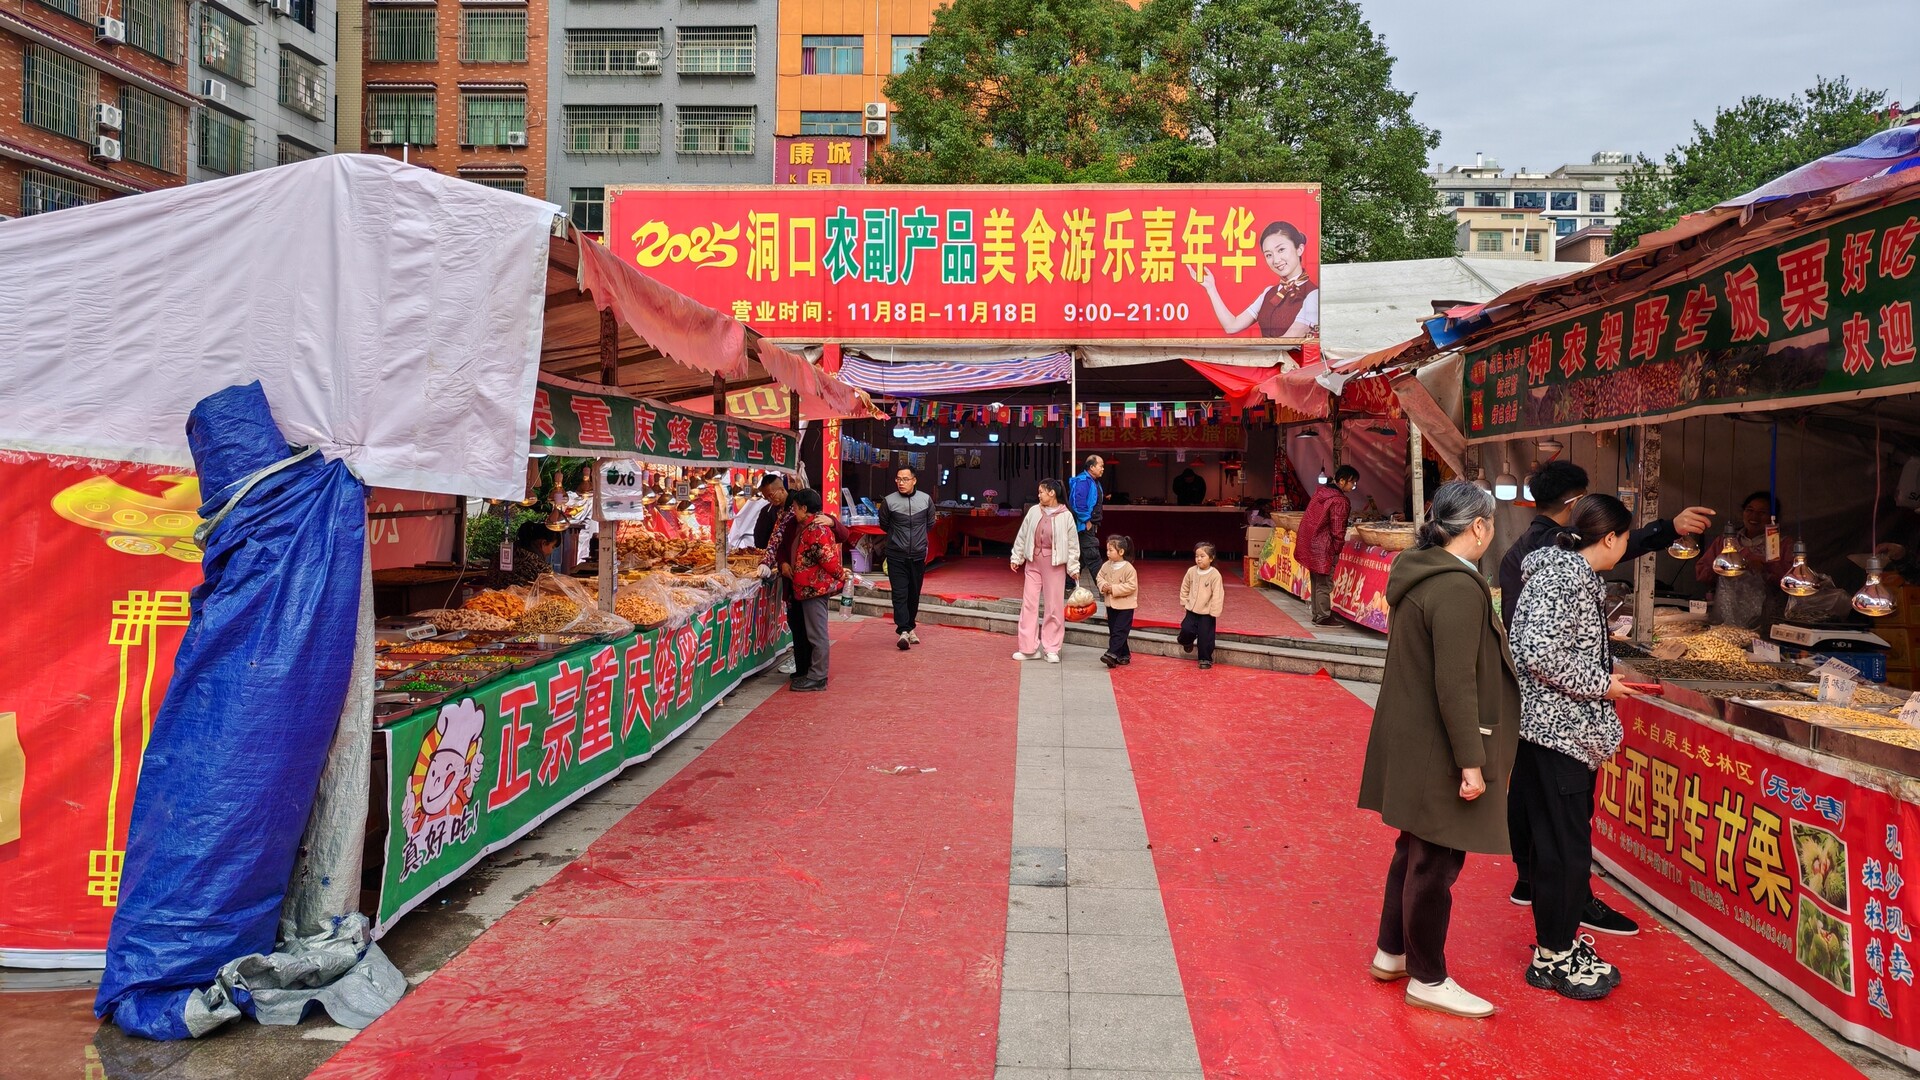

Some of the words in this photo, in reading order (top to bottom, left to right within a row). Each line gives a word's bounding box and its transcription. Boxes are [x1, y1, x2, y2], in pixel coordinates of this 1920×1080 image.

[789, 142, 852, 165] 康城
[1064, 302, 1189, 322] 9:00-21:00
[1527, 238, 1829, 385] 神农架野生板栗
[1842, 300, 1916, 376] 欢迎
[1078, 425, 1240, 443] 湘西农家柴火腊肉
[1632, 716, 1754, 786] 来自原生态林区
[1862, 857, 1892, 1019] 粒粒精选
[1885, 824, 1912, 986] 现炒现卖
